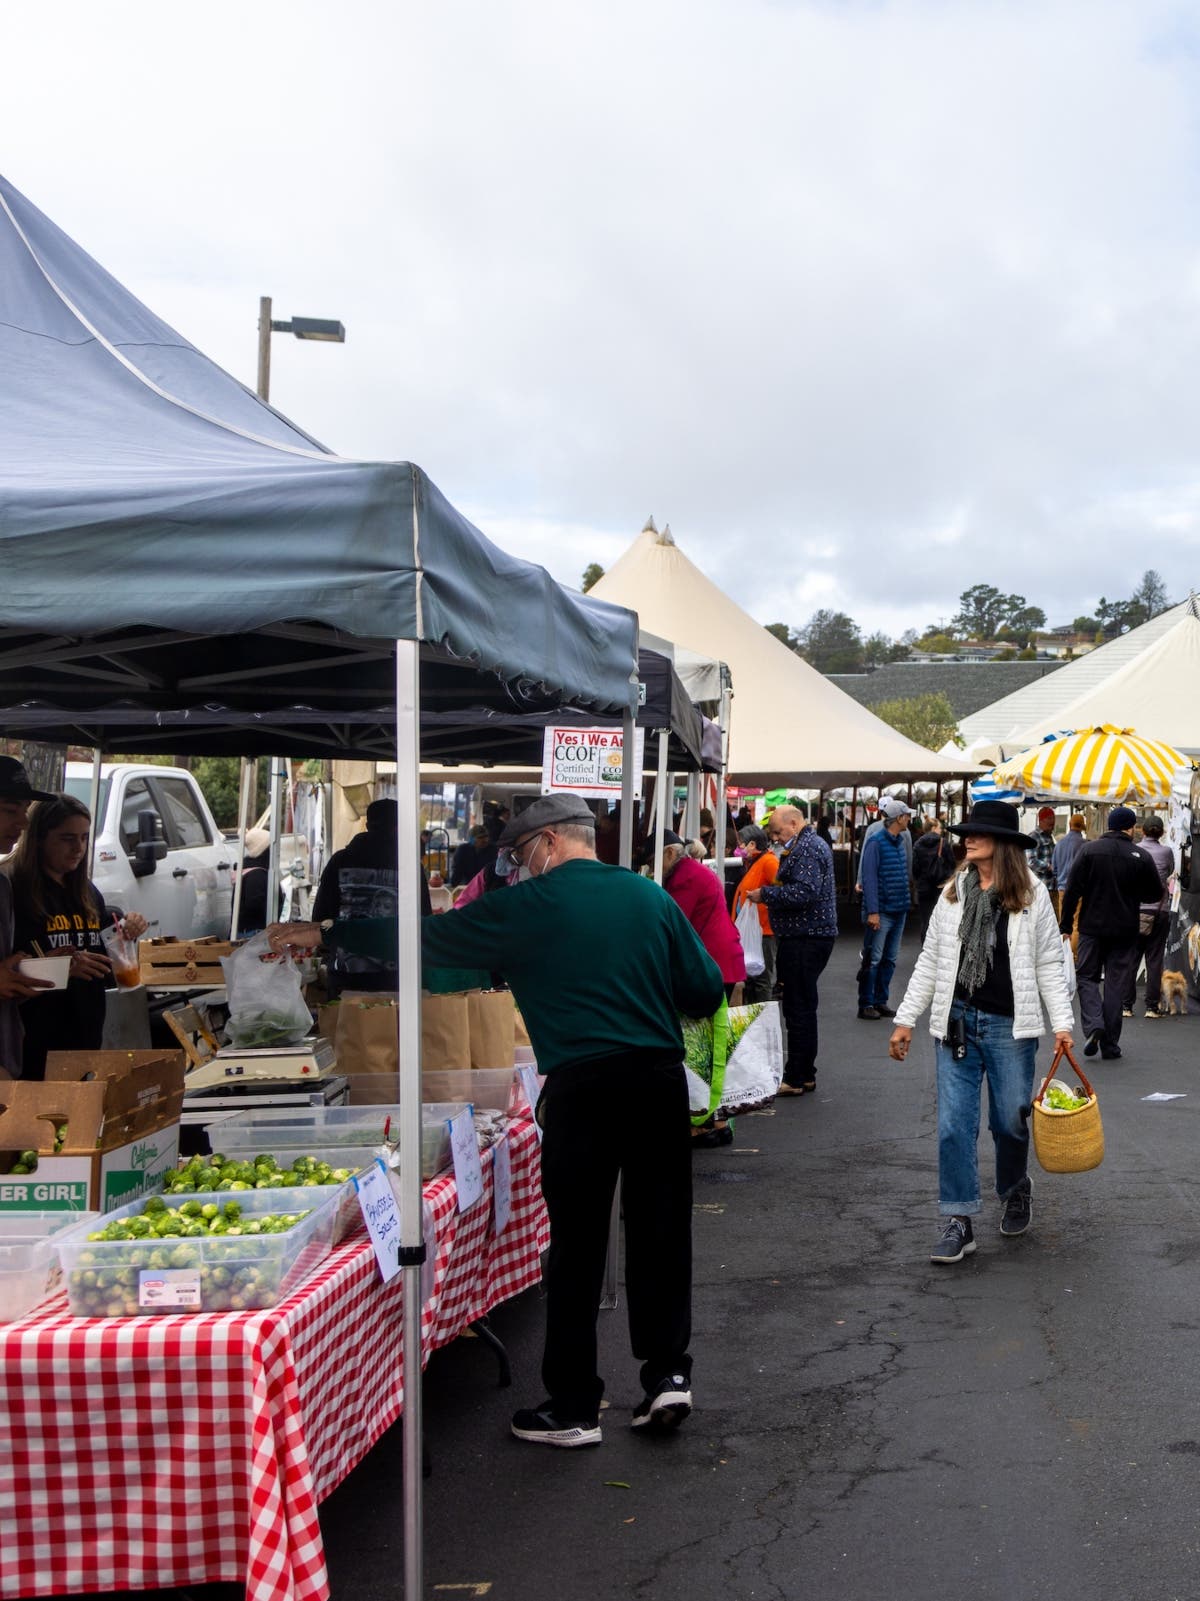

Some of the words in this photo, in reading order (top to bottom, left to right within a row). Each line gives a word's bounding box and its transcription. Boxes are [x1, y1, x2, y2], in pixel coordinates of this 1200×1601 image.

[556, 732, 578, 745] Yes
[588, 733, 608, 747] We
[555, 745, 597, 762] CCOF
[556, 762, 594, 774] Certified
[555, 773, 594, 785] Organic
[33, 1184, 82, 1201] GIRL
